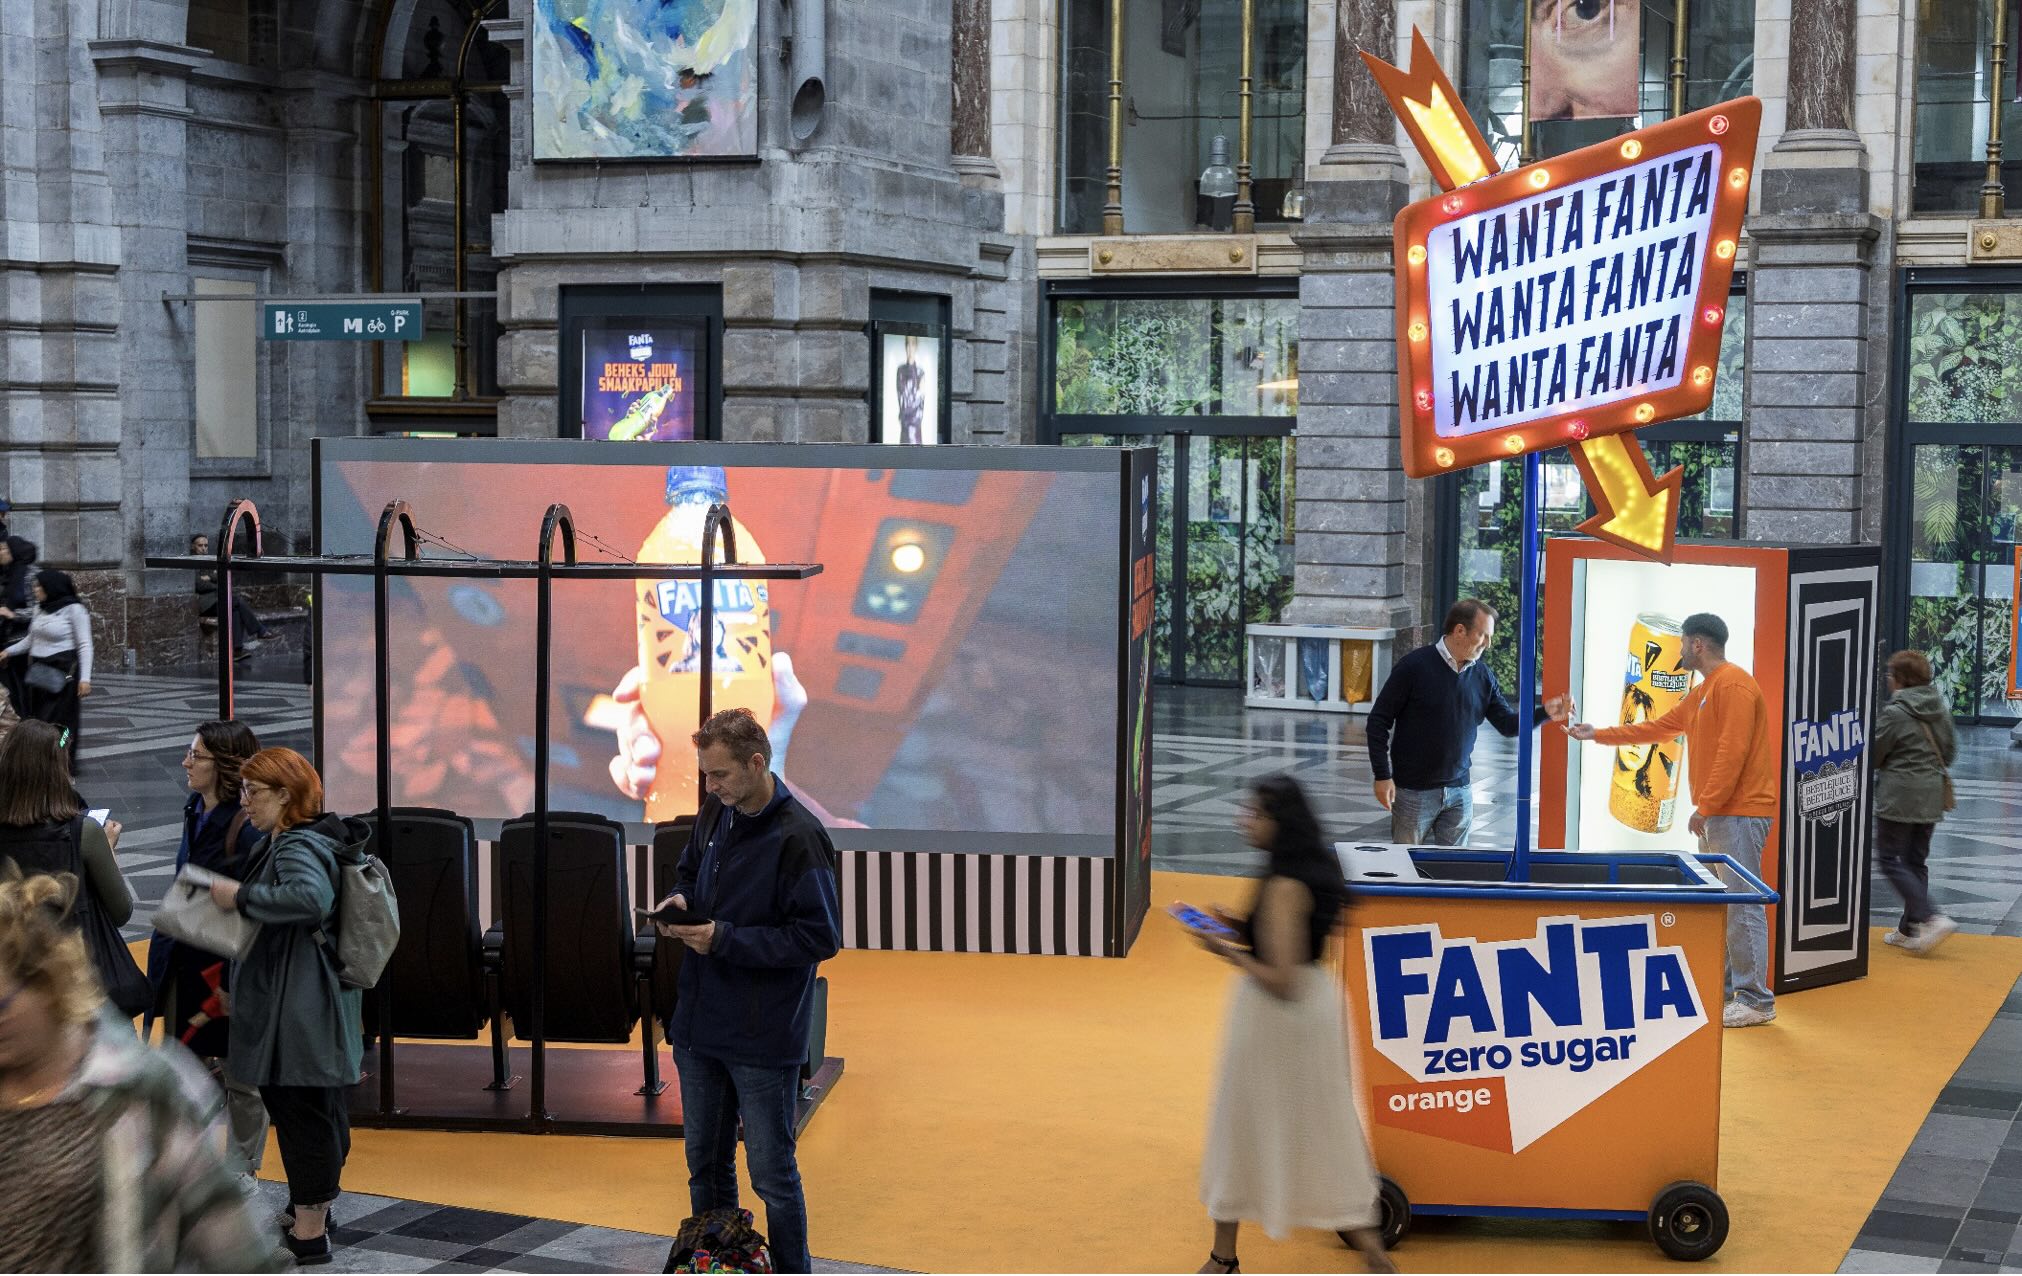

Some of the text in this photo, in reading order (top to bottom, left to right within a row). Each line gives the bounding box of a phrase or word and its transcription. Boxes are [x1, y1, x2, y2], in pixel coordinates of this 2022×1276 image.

[1451, 150, 1714, 285] WANTA FANTA
[1451, 231, 1698, 356] WANTA FANTA
[628, 334, 654, 346] FANTA
[604, 363, 678, 378] BEHEKS JOUW
[1450, 313, 1682, 427] WANTA FANTA
[1793, 711, 1864, 763] FANTA
[1371, 923, 1698, 1044] FANTA
[1423, 1034, 1637, 1075] zero sugar
[1388, 1087, 1491, 1113] orange
